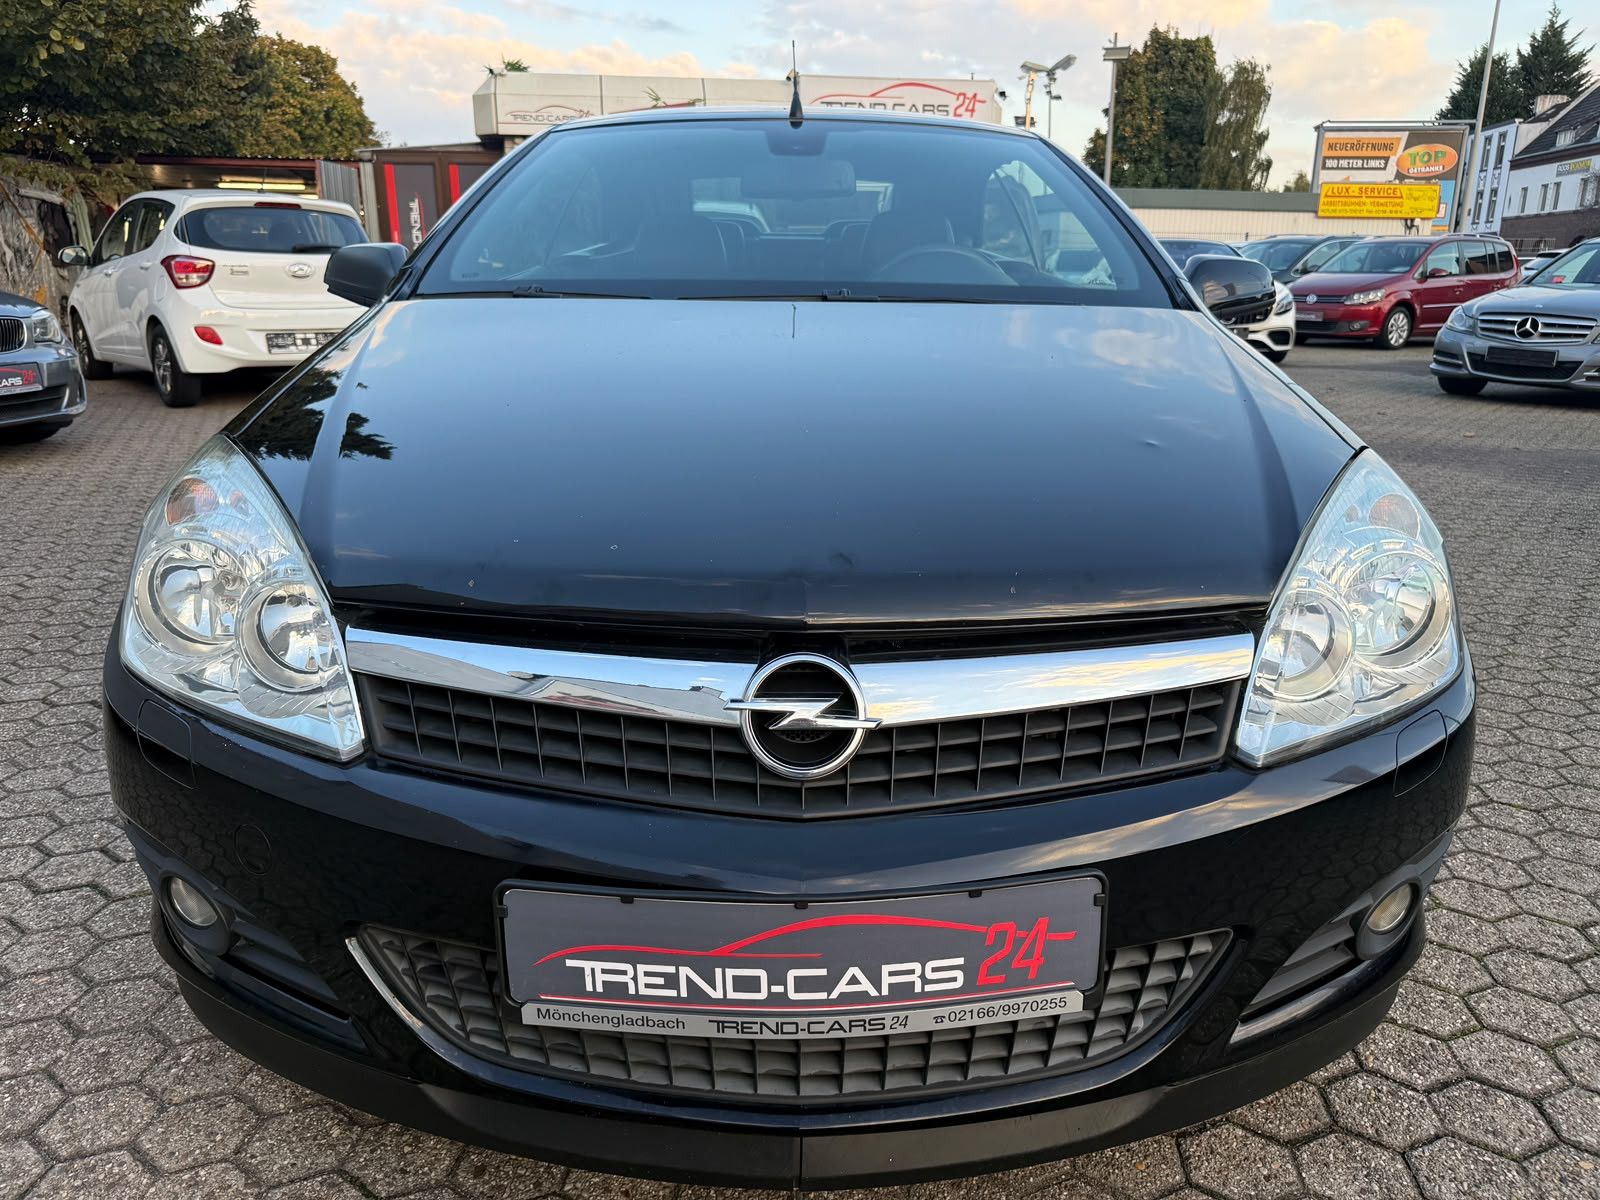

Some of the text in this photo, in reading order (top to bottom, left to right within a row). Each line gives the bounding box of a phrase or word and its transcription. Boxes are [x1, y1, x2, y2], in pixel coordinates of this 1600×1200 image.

[953, 92, 979, 118] 24
[1327, 140, 1394, 151] NEUERÖFFNUNG
[1325, 159, 1386, 168] 100 METER LINKS
[1408, 150, 1446, 166] TOP
[1330, 186, 1352, 195] LUX
[1358, 187, 1399, 196] SERVICE
[0, 377, 22, 387] ARS
[565, 916, 1050, 1001] TREND-CARS 24
[536, 996, 1068, 1036] Mönchengladbach TREND-CARS 24 02166/9970255
